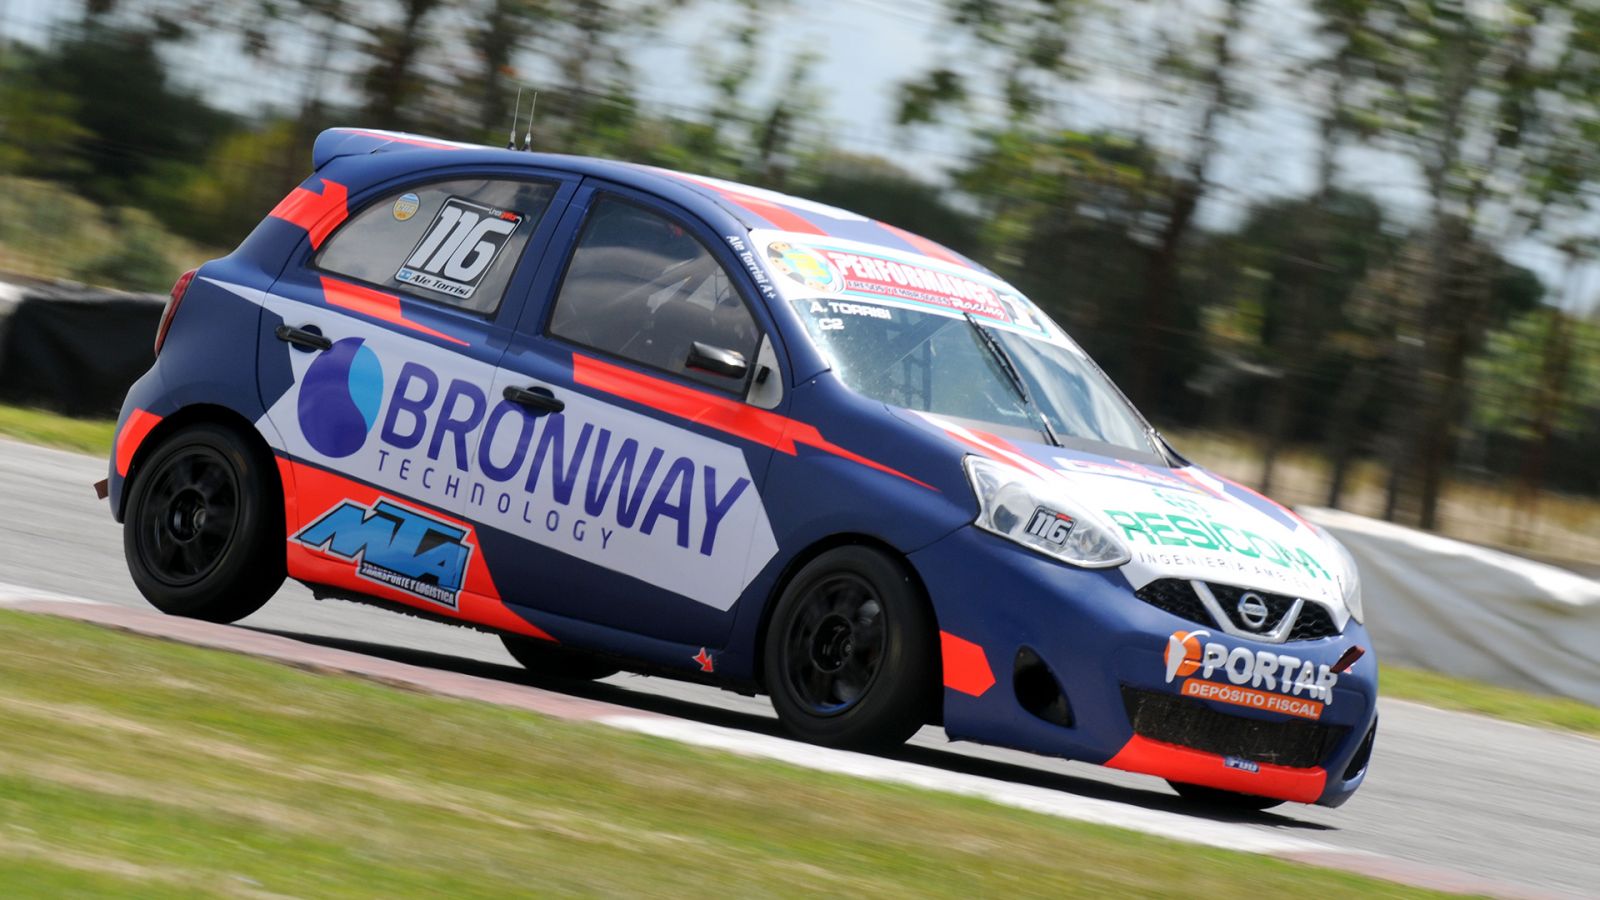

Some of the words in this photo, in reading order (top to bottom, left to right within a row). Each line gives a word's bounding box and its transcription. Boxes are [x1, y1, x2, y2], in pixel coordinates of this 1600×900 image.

[407, 206, 516, 281] 116
[726, 236, 745, 250] Ale
[740, 251, 769, 283] Torrisi
[410, 275, 431, 285] Ale
[433, 280, 470, 296] Torrisi
[828, 252, 1000, 308] PERFORMANCE
[810, 302, 828, 313] A.
[828, 302, 892, 320] TORRISI
[819, 318, 845, 330] C2
[949, 297, 1005, 319] Racing
[381, 361, 750, 557] BRONWAY
[379, 450, 613, 549] TECHNOLOGY
[296, 500, 468, 592] MTA
[1029, 511, 1072, 544] 116
[1103, 509, 1332, 581] RESICOM
[362, 562, 410, 589] TRANSPORTE
[415, 582, 454, 605] LOGISTICA
[1203, 642, 1338, 706] PORTAR
[1189, 682, 1265, 706] DEPÓSITO
[1267, 696, 1318, 717] FISCAL
